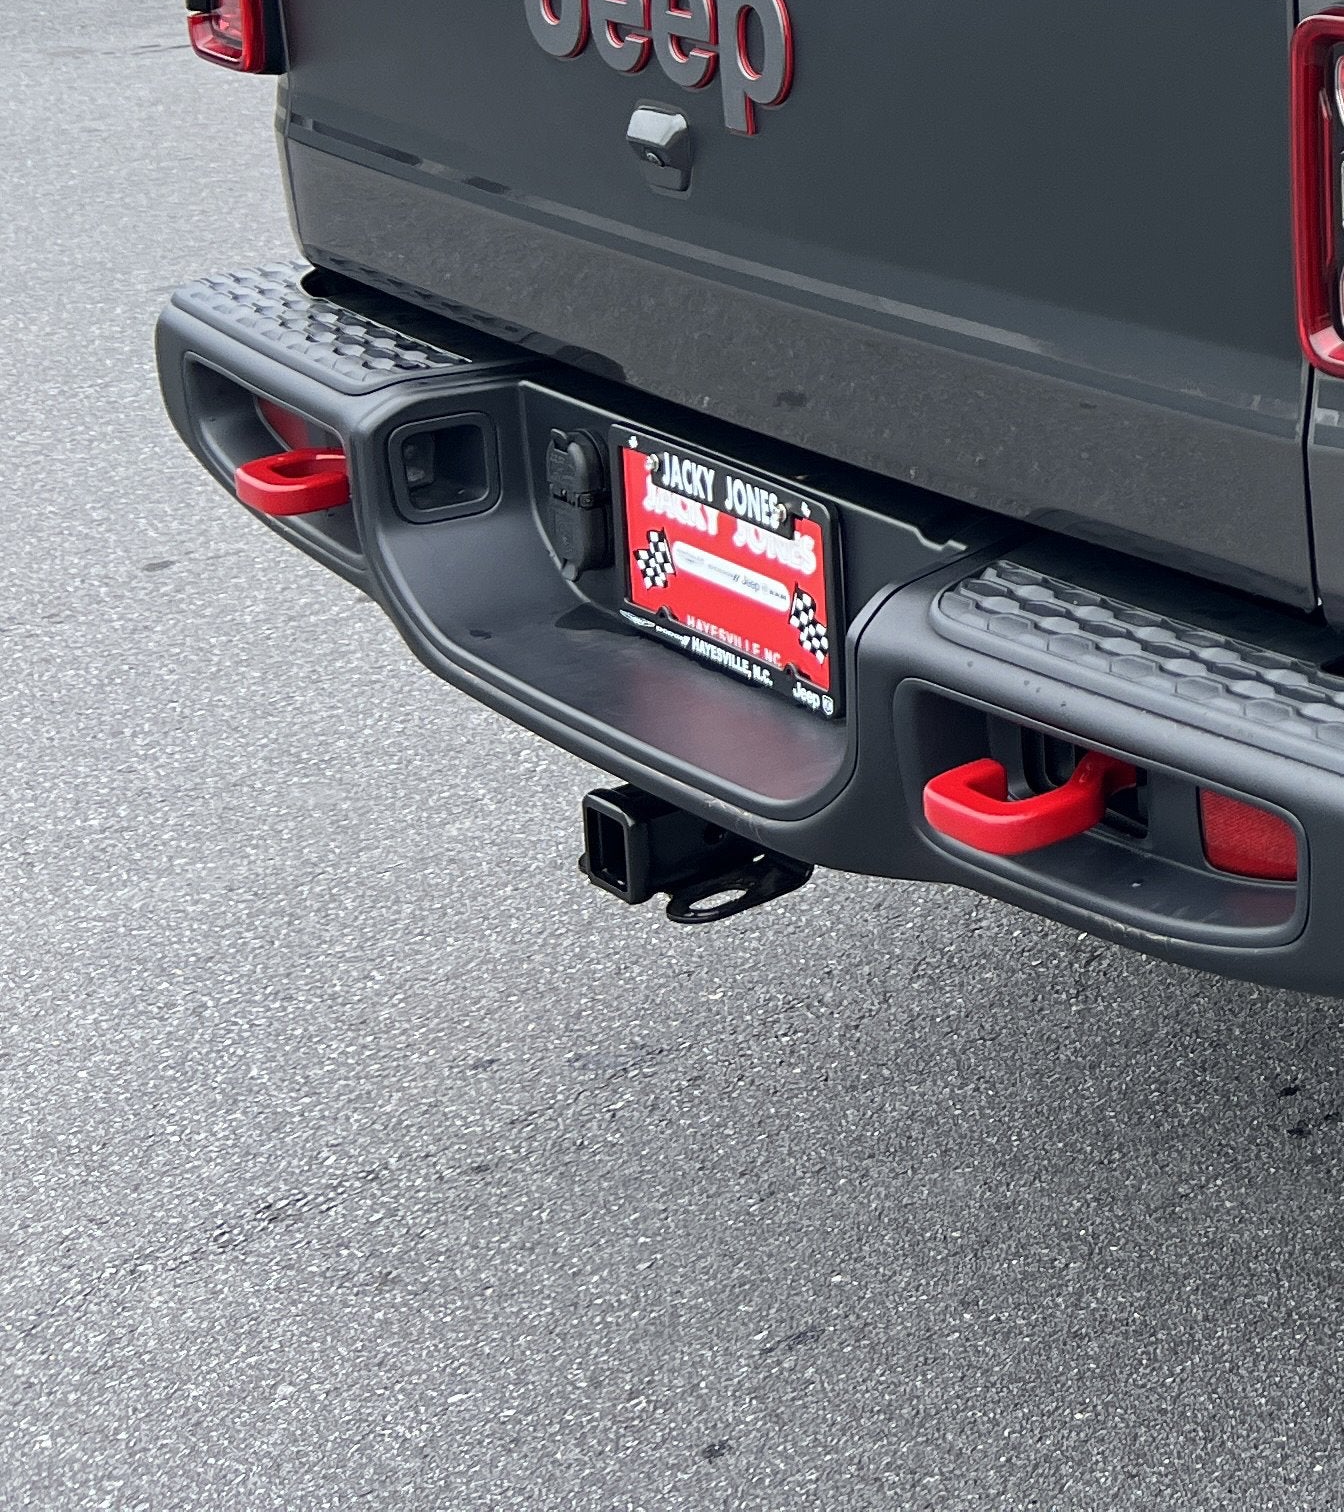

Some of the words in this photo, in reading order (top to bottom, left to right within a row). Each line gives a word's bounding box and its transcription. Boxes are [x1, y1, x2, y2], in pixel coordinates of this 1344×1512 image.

[662, 451, 716, 503] JACKY
[724, 475, 780, 530] JONES
[792, 681, 821, 711] Jeep
